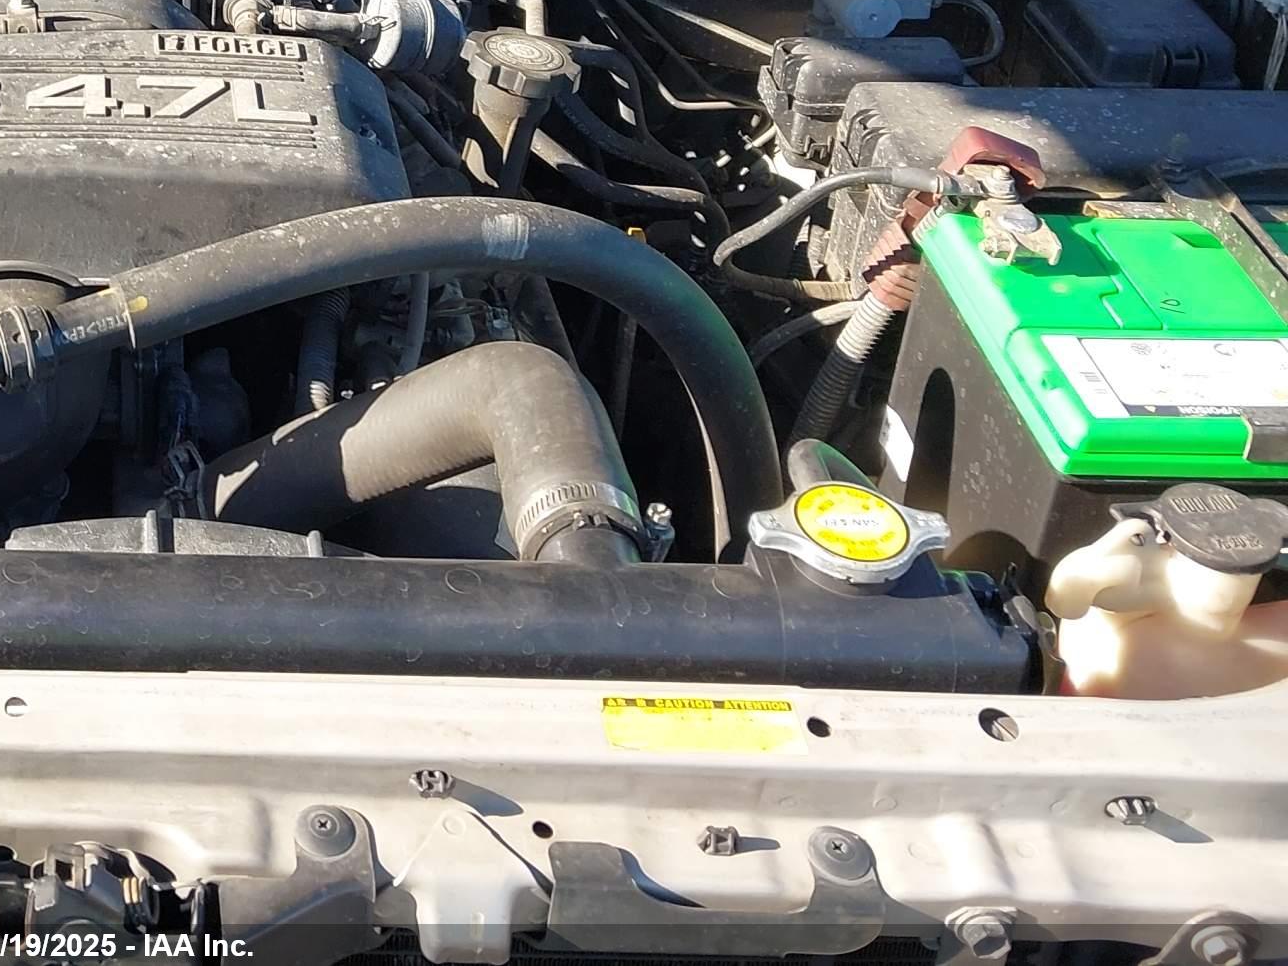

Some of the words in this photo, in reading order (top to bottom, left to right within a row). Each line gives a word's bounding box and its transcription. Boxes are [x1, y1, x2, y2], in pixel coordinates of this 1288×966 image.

[193, 35, 298, 57] FORCE
[26, 72, 318, 126] 4.7L
[654, 698, 714, 709] CAUTION
[723, 700, 792, 712] ATTENTION
